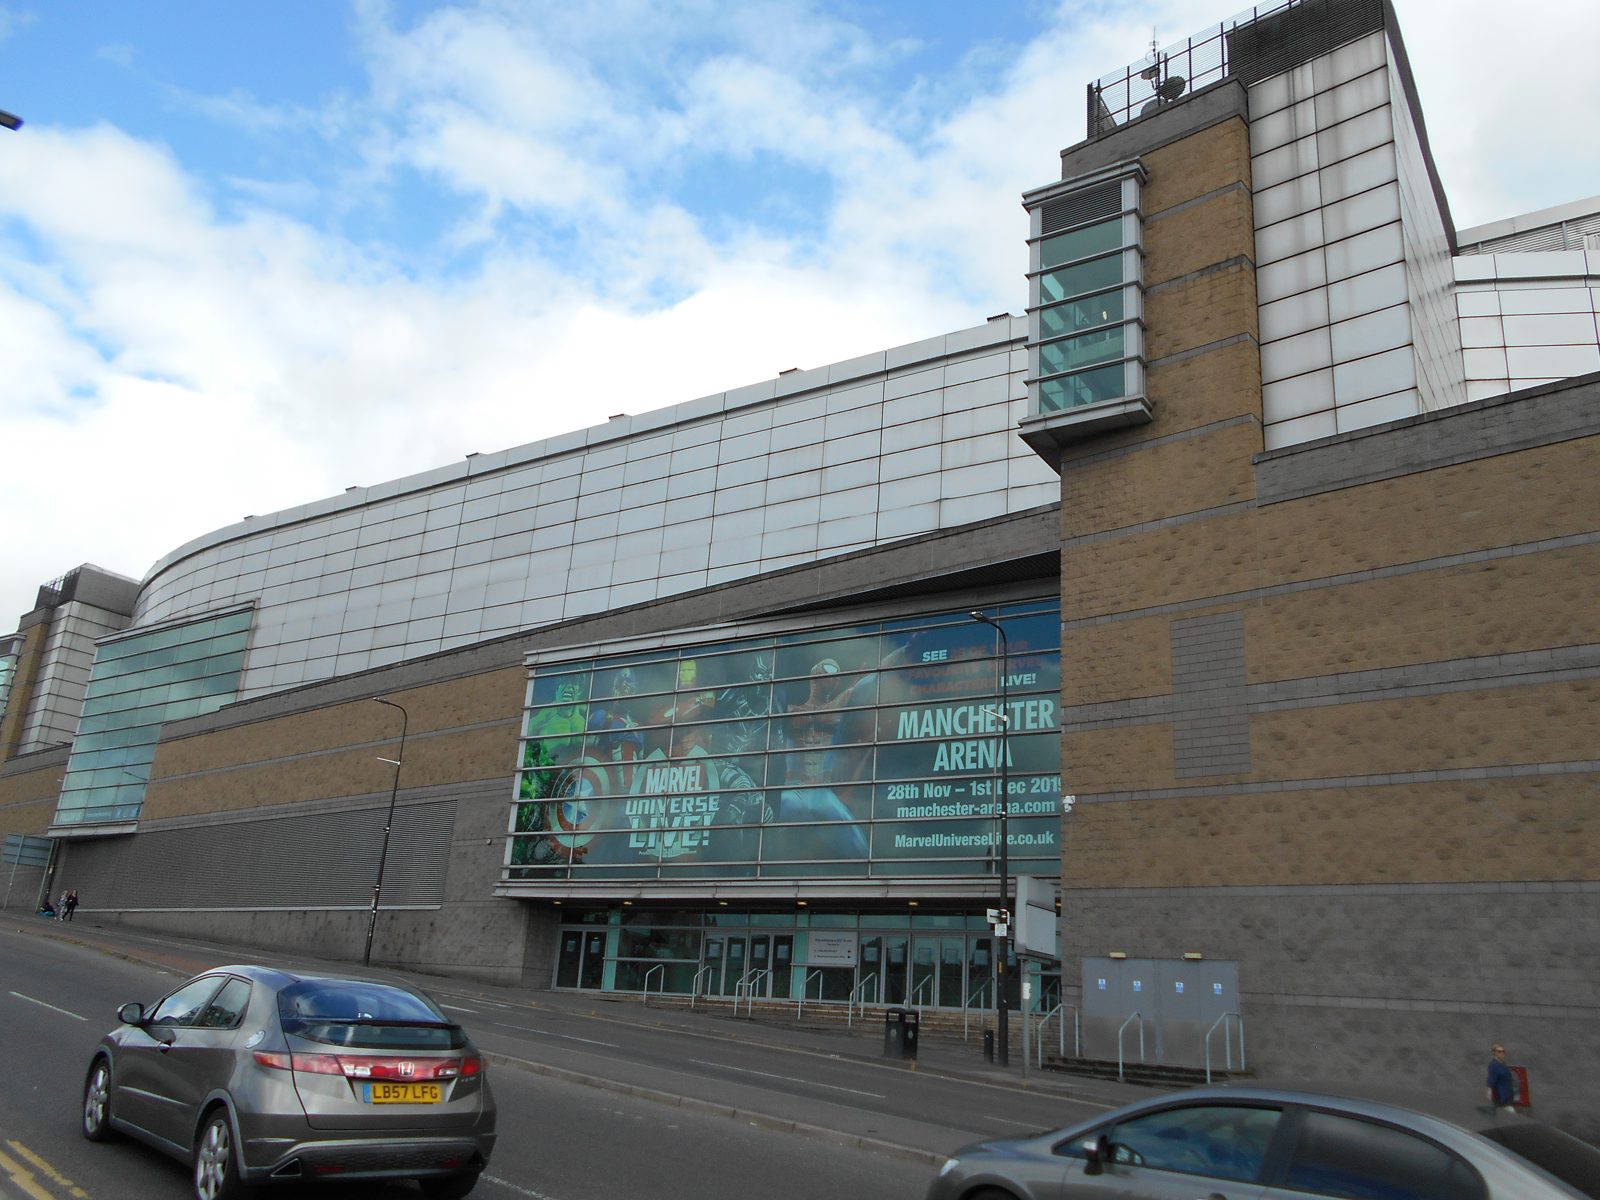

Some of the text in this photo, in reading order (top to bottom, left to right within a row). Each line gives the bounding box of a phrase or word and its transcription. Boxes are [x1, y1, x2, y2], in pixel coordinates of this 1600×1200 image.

[922, 649, 947, 662] SEE
[1000, 673, 1036, 687] LIVE!
[897, 699, 1054, 739] MANCHESTER
[933, 739, 1013, 772] ARENA
[645, 765, 702, 794] MARVEL
[887, 784, 919, 800] 28th
[923, 782, 951, 798] Nov
[969, 780, 992, 796] 1st
[629, 815, 711, 848] LIVE!
[895, 830, 1054, 848] MarvelUniverseLie.co.uk
[373, 1085, 438, 1099] LB57 LFG
